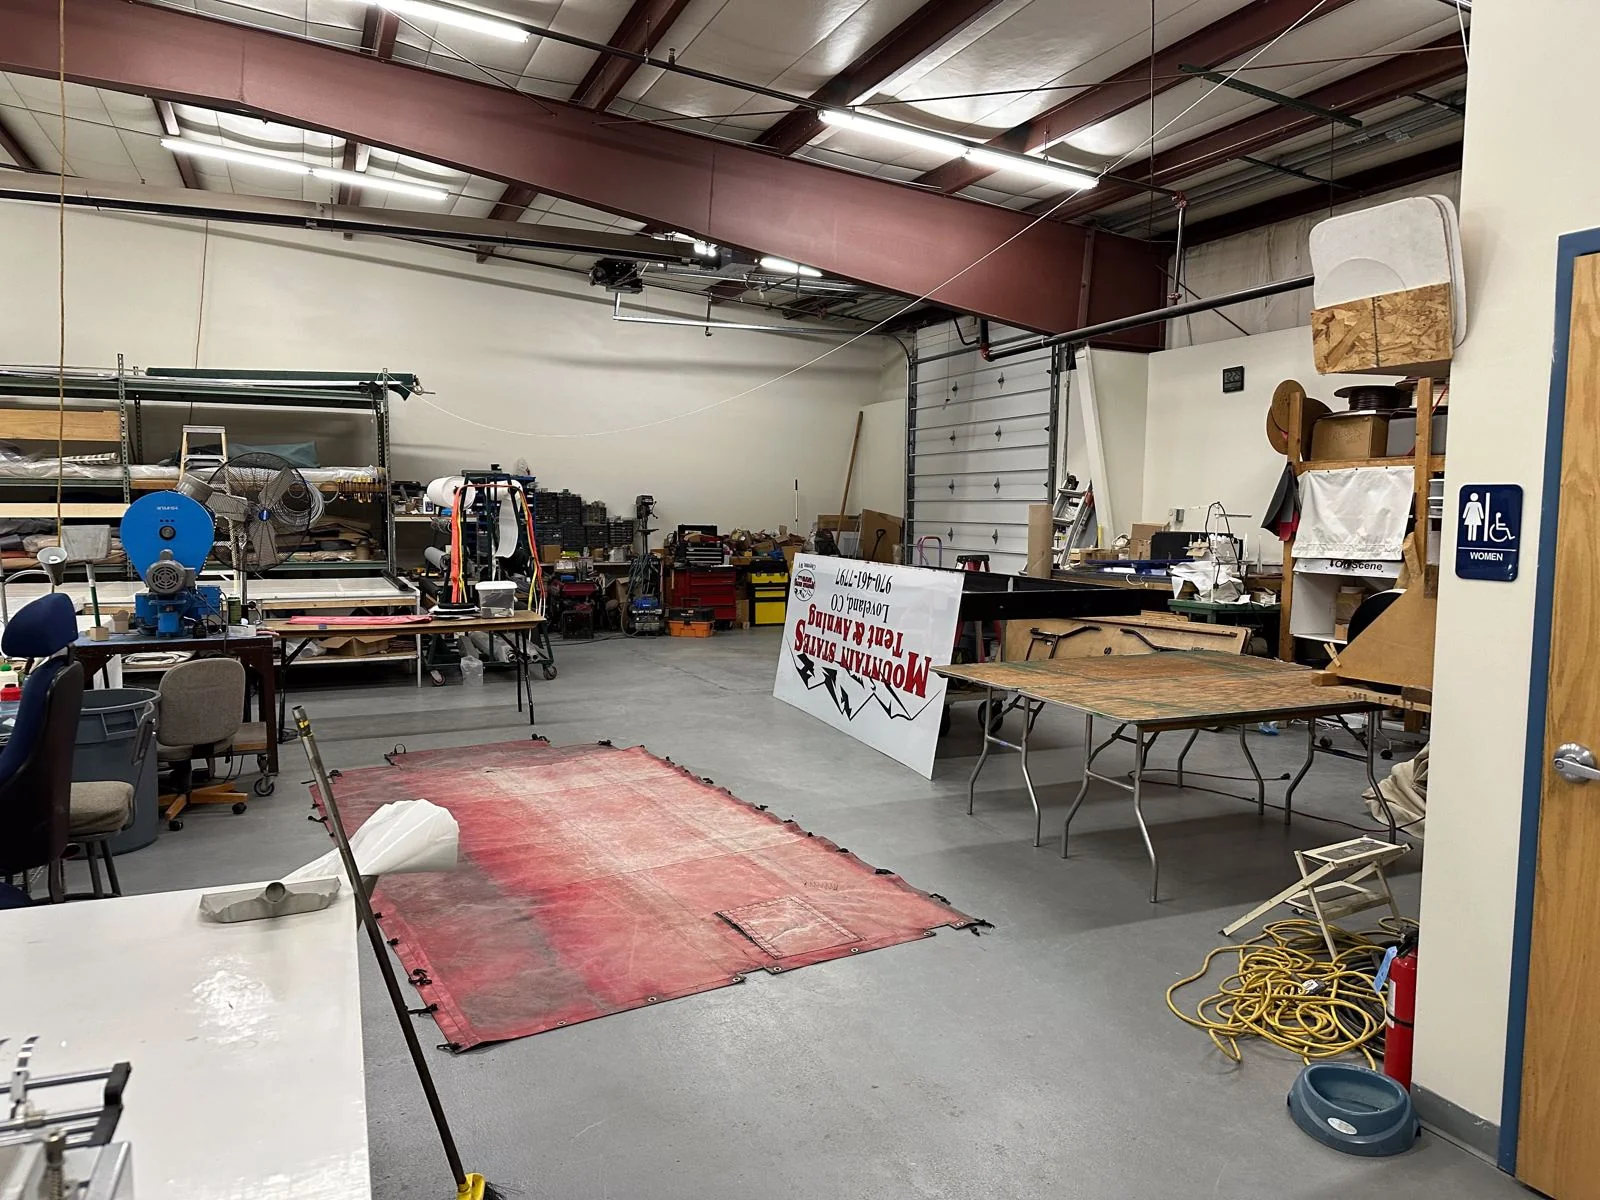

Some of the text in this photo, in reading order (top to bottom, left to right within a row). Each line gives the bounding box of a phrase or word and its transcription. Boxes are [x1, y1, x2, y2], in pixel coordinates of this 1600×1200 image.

[1351, 562, 1383, 571] Scene
[1469, 552, 1503, 561] WOMEN
[835, 568, 892, 594] 970-461-7797
[831, 593, 890, 623] Loveland, CO
[807, 603, 904, 658] Tent & Awning
[794, 619, 932, 698] MOUNTAIN STATES
